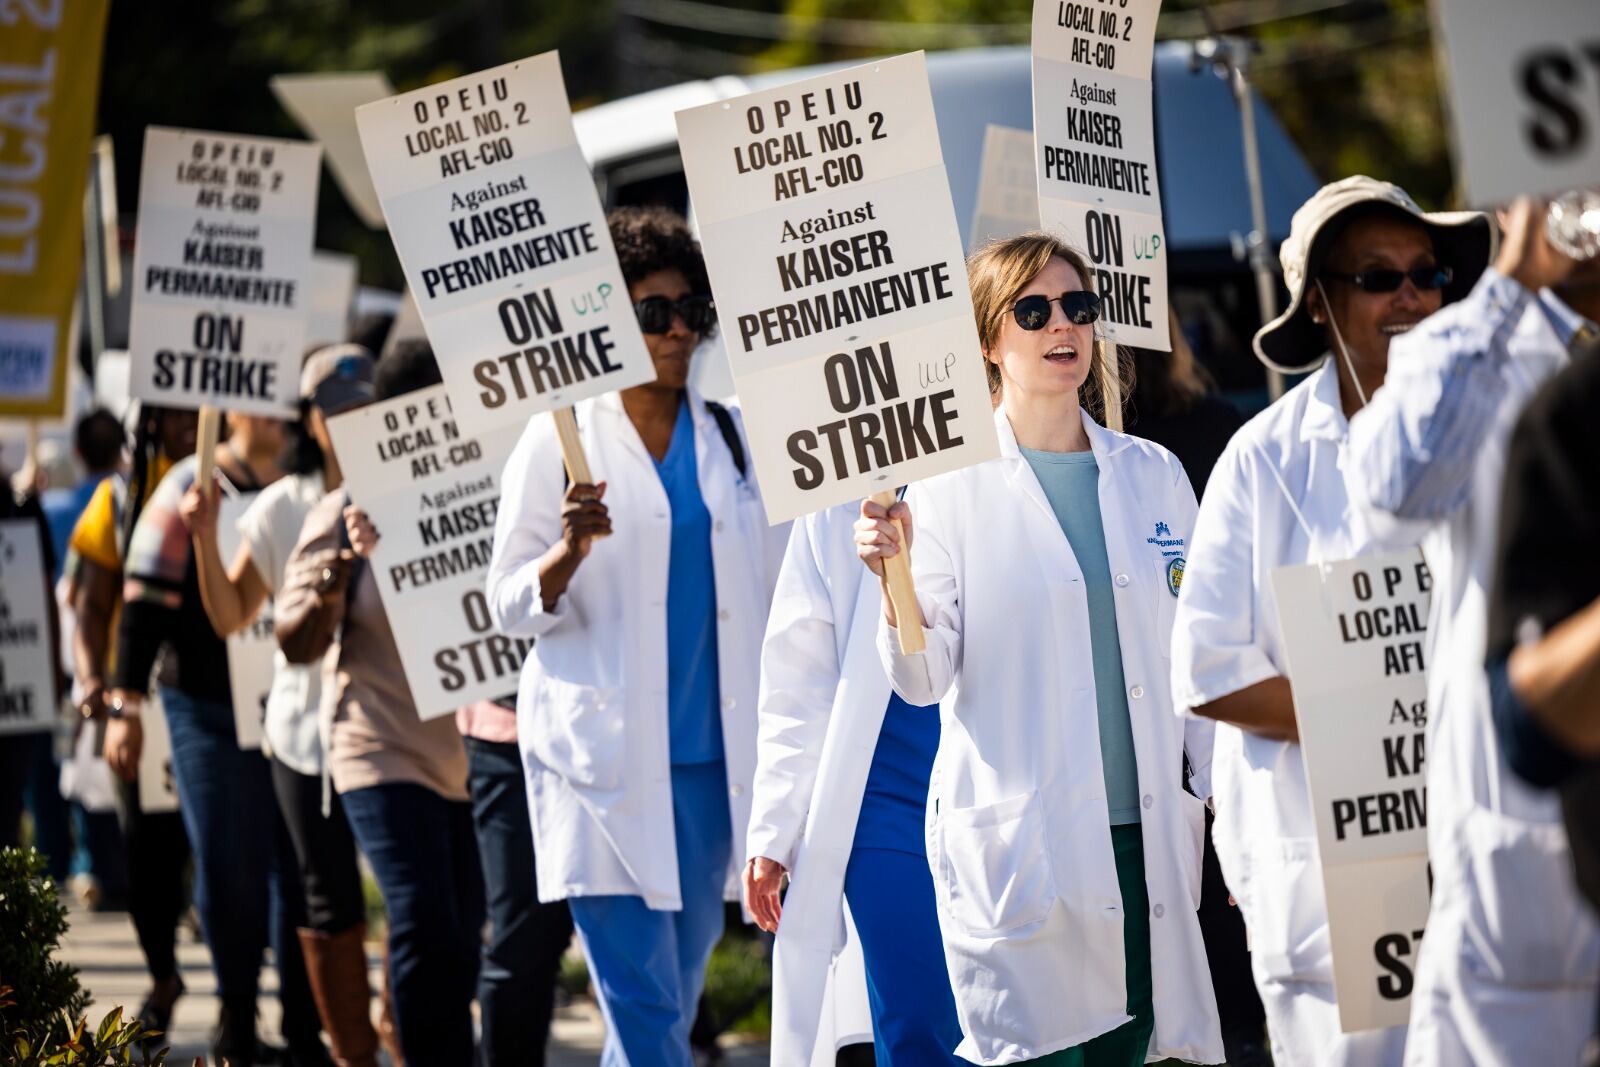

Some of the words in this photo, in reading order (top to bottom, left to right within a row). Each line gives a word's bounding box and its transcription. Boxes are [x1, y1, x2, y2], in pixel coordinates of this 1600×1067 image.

[1057, 1, 1095, 34] LOCAL
[1099, 10, 1119, 39] NO.
[1123, 16, 1133, 41] 2
[1071, 37, 1116, 70] AFL-CIO
[1070, 78, 1117, 106] Against
[405, 120, 470, 157] LOCAL
[473, 109, 510, 138] NO.
[514, 102, 530, 126] 2
[734, 131, 812, 174] LOCAL
[817, 120, 862, 153] NO.
[868, 112, 888, 141] 2
[1067, 106, 1123, 149] KAISER
[176, 163, 228, 185] LOCAL
[271, 173, 285, 192] 2
[440, 137, 514, 178] AFL-CIO
[774, 153, 864, 201] AFL-CIO
[1044, 145, 1151, 196] PERMANENTE
[195, 190, 261, 213] AFL-CIO
[451, 175, 527, 211] Against
[192, 218, 260, 241] Against
[449, 198, 546, 250] KAISER
[780, 201, 876, 244] Against
[1085, 210, 1124, 267] ON
[183, 238, 264, 271] KAISER
[421, 222, 599, 299] PERMANENTE
[776, 229, 894, 292] KAISER
[1133, 234, 1161, 260] ULP
[145, 266, 297, 308] PERMANENTE
[571, 282, 613, 316] ULP
[738, 261, 953, 352] PERMANENTE
[1088, 267, 1153, 329] RIKE
[193, 312, 244, 354] ON
[497, 288, 564, 345] ON
[153, 350, 278, 401] STRIKE
[473, 325, 623, 409] STRIKE
[824, 341, 900, 414] ON
[377, 427, 437, 462] LOCAL
[411, 440, 482, 480] AFL-CIO
[786, 389, 965, 491] STRIKE
[420, 475, 494, 511] Against
[1338, 603, 1427, 643] LOCAL
